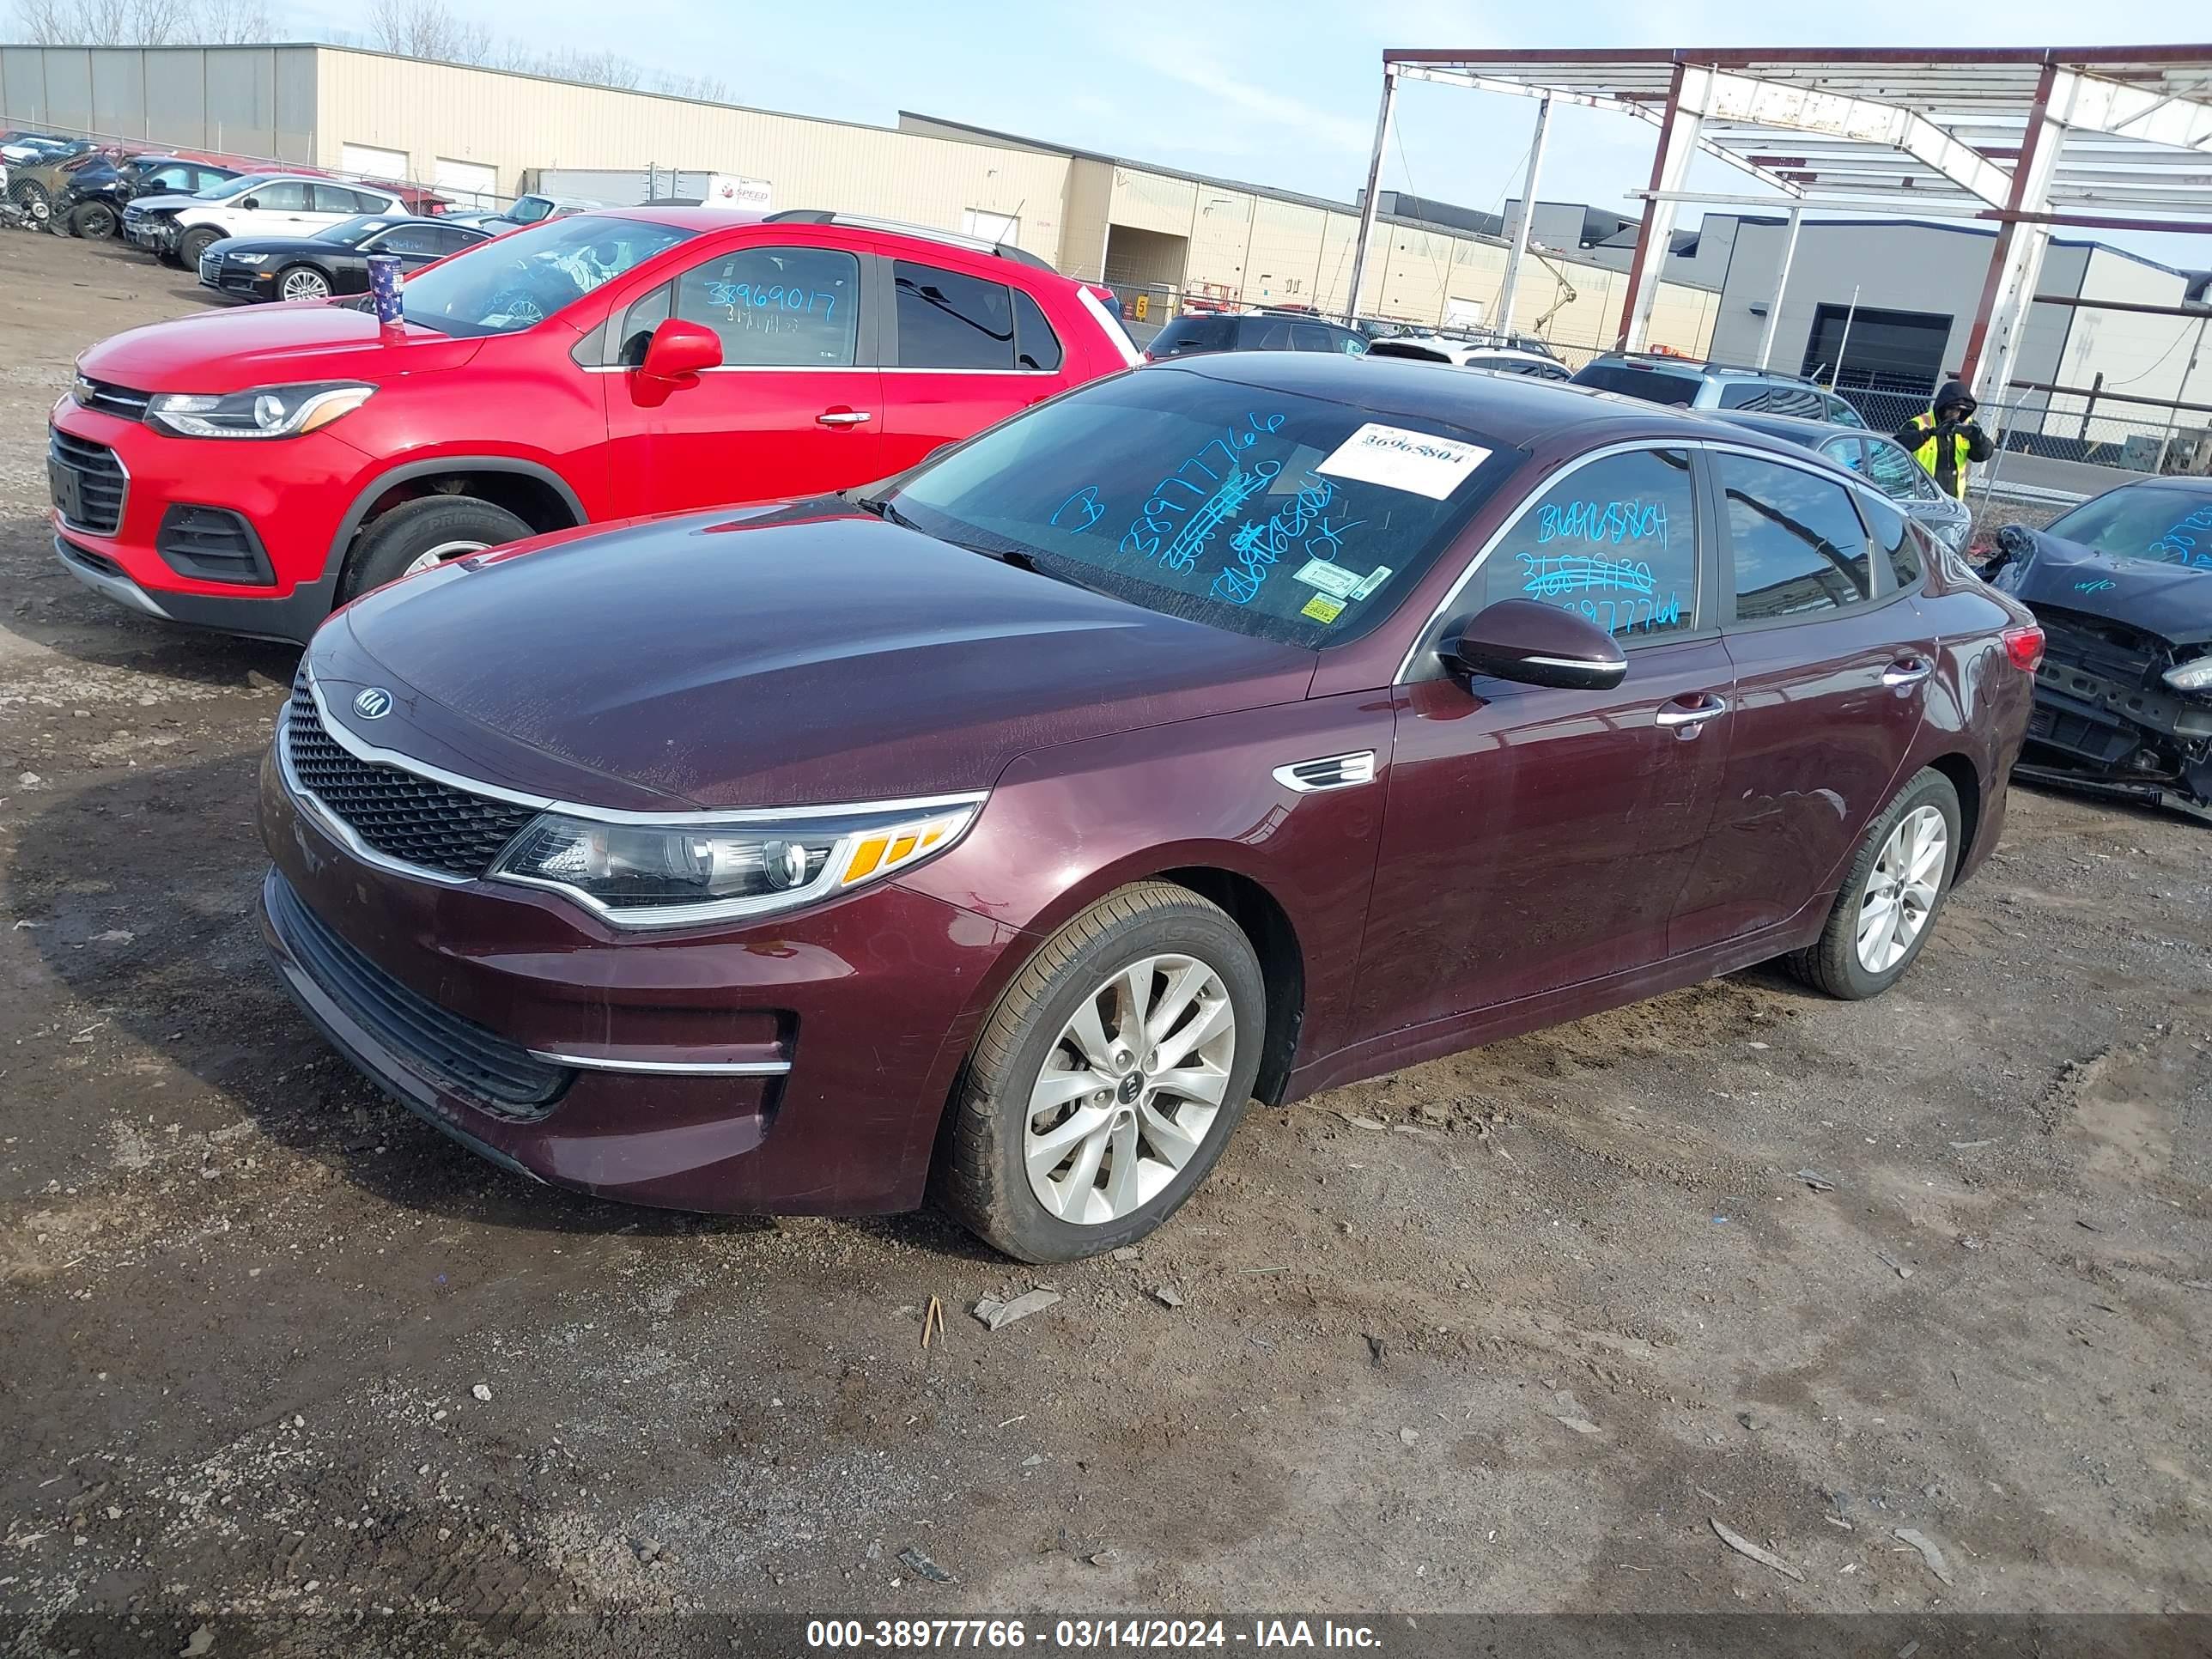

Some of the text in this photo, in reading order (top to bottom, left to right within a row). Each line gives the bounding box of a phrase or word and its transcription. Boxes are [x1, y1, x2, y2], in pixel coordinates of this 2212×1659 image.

[736, 188, 769, 200] SPEED
[704, 282, 836, 323] 38969017
[1138, 301, 1146, 313] 5
[1120, 412, 1285, 557] 38977766
